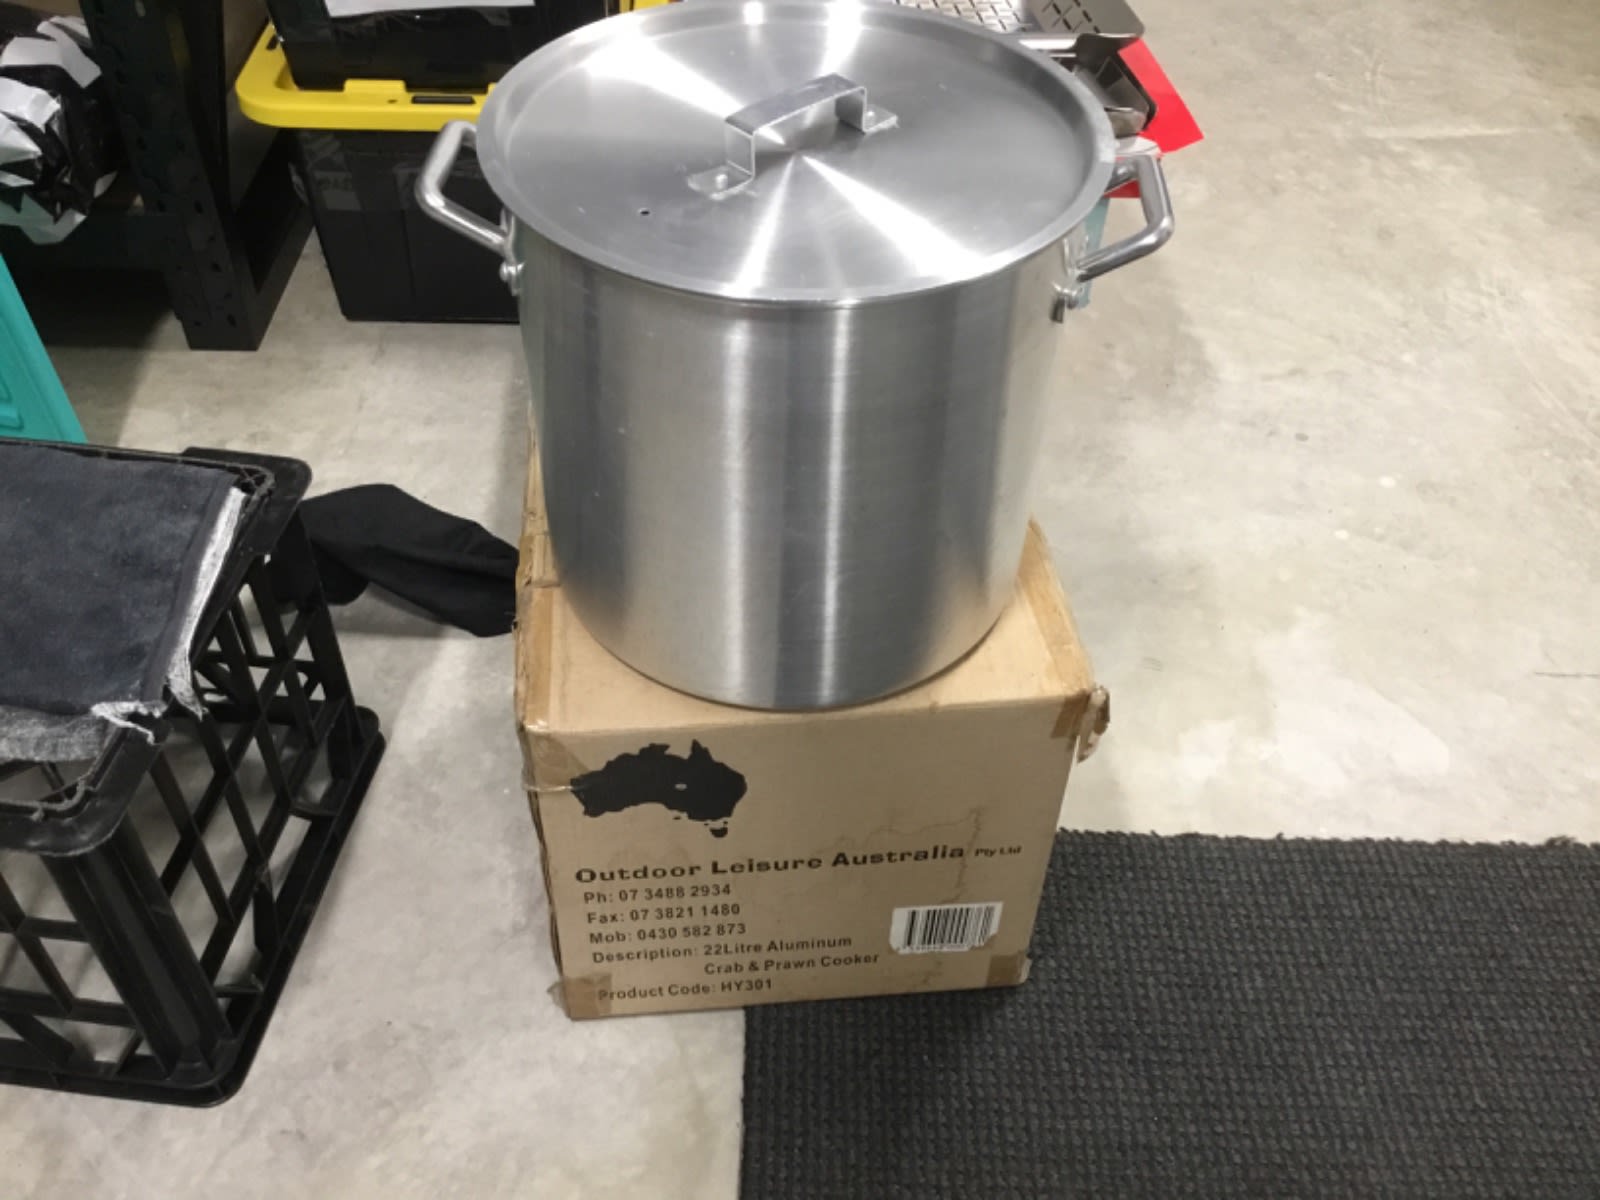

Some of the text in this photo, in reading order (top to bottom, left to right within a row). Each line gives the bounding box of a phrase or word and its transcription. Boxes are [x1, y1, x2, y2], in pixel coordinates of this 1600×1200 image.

[575, 865, 701, 883] Outdoor
[711, 857, 823, 875] Leisure
[831, 844, 964, 867] Australia
[584, 883, 731, 904] Ph: 07 3488 2934
[586, 903, 741, 924] Fax: 07 3821 1480
[589, 922, 746, 944] Mob: 0430 582 873
[592, 937, 852, 963] Description: 22Litre Aluminum
[704, 953, 880, 975] Crab & Prawn Cooker
[598, 978, 772, 1001] Product Code: HY301
